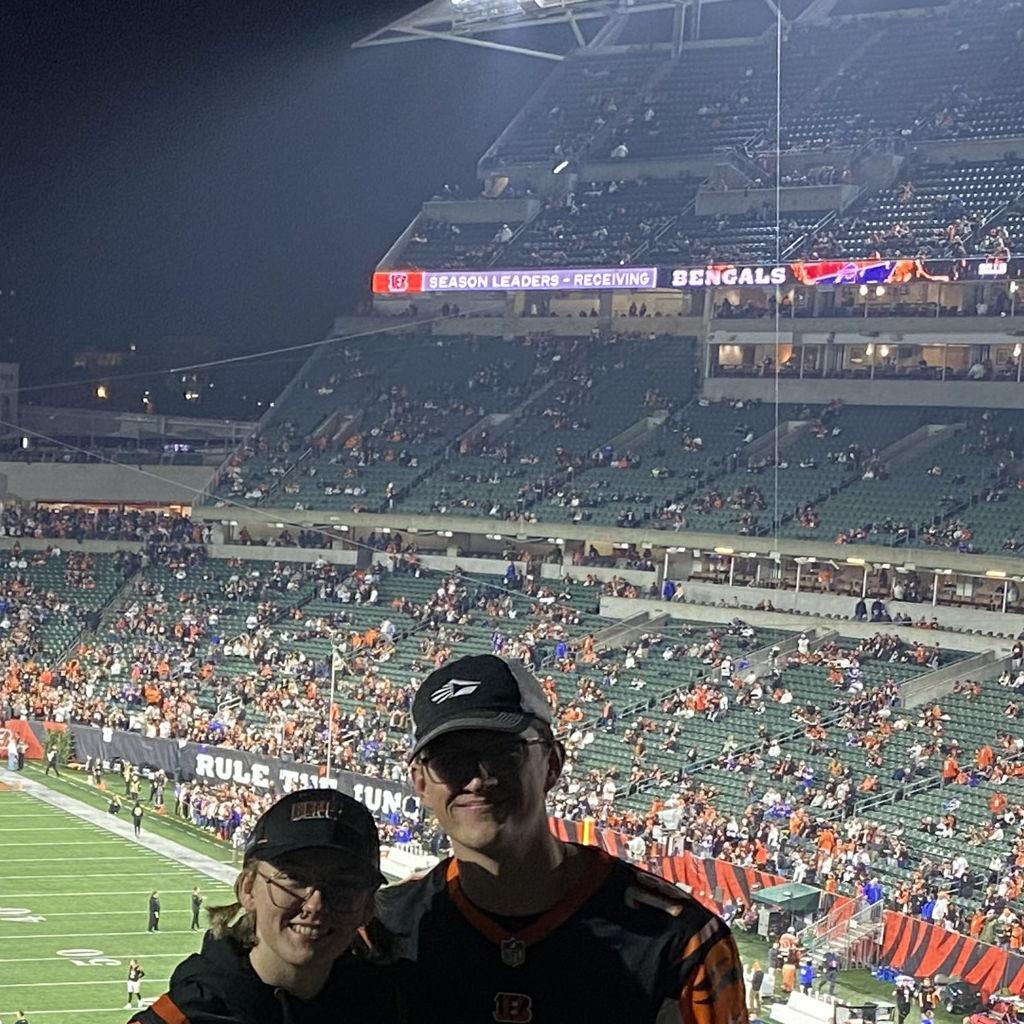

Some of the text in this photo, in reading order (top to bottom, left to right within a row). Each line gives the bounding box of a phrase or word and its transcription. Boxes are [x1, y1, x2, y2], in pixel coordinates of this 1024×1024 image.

[428, 275, 488, 289] SEASON
[491, 274, 560, 288] LEADERS
[573, 271, 651, 287] RECEIVING
[671, 266, 787, 286] BENGALS
[195, 753, 271, 789] RULE
[491, 991, 534, 1024] B
